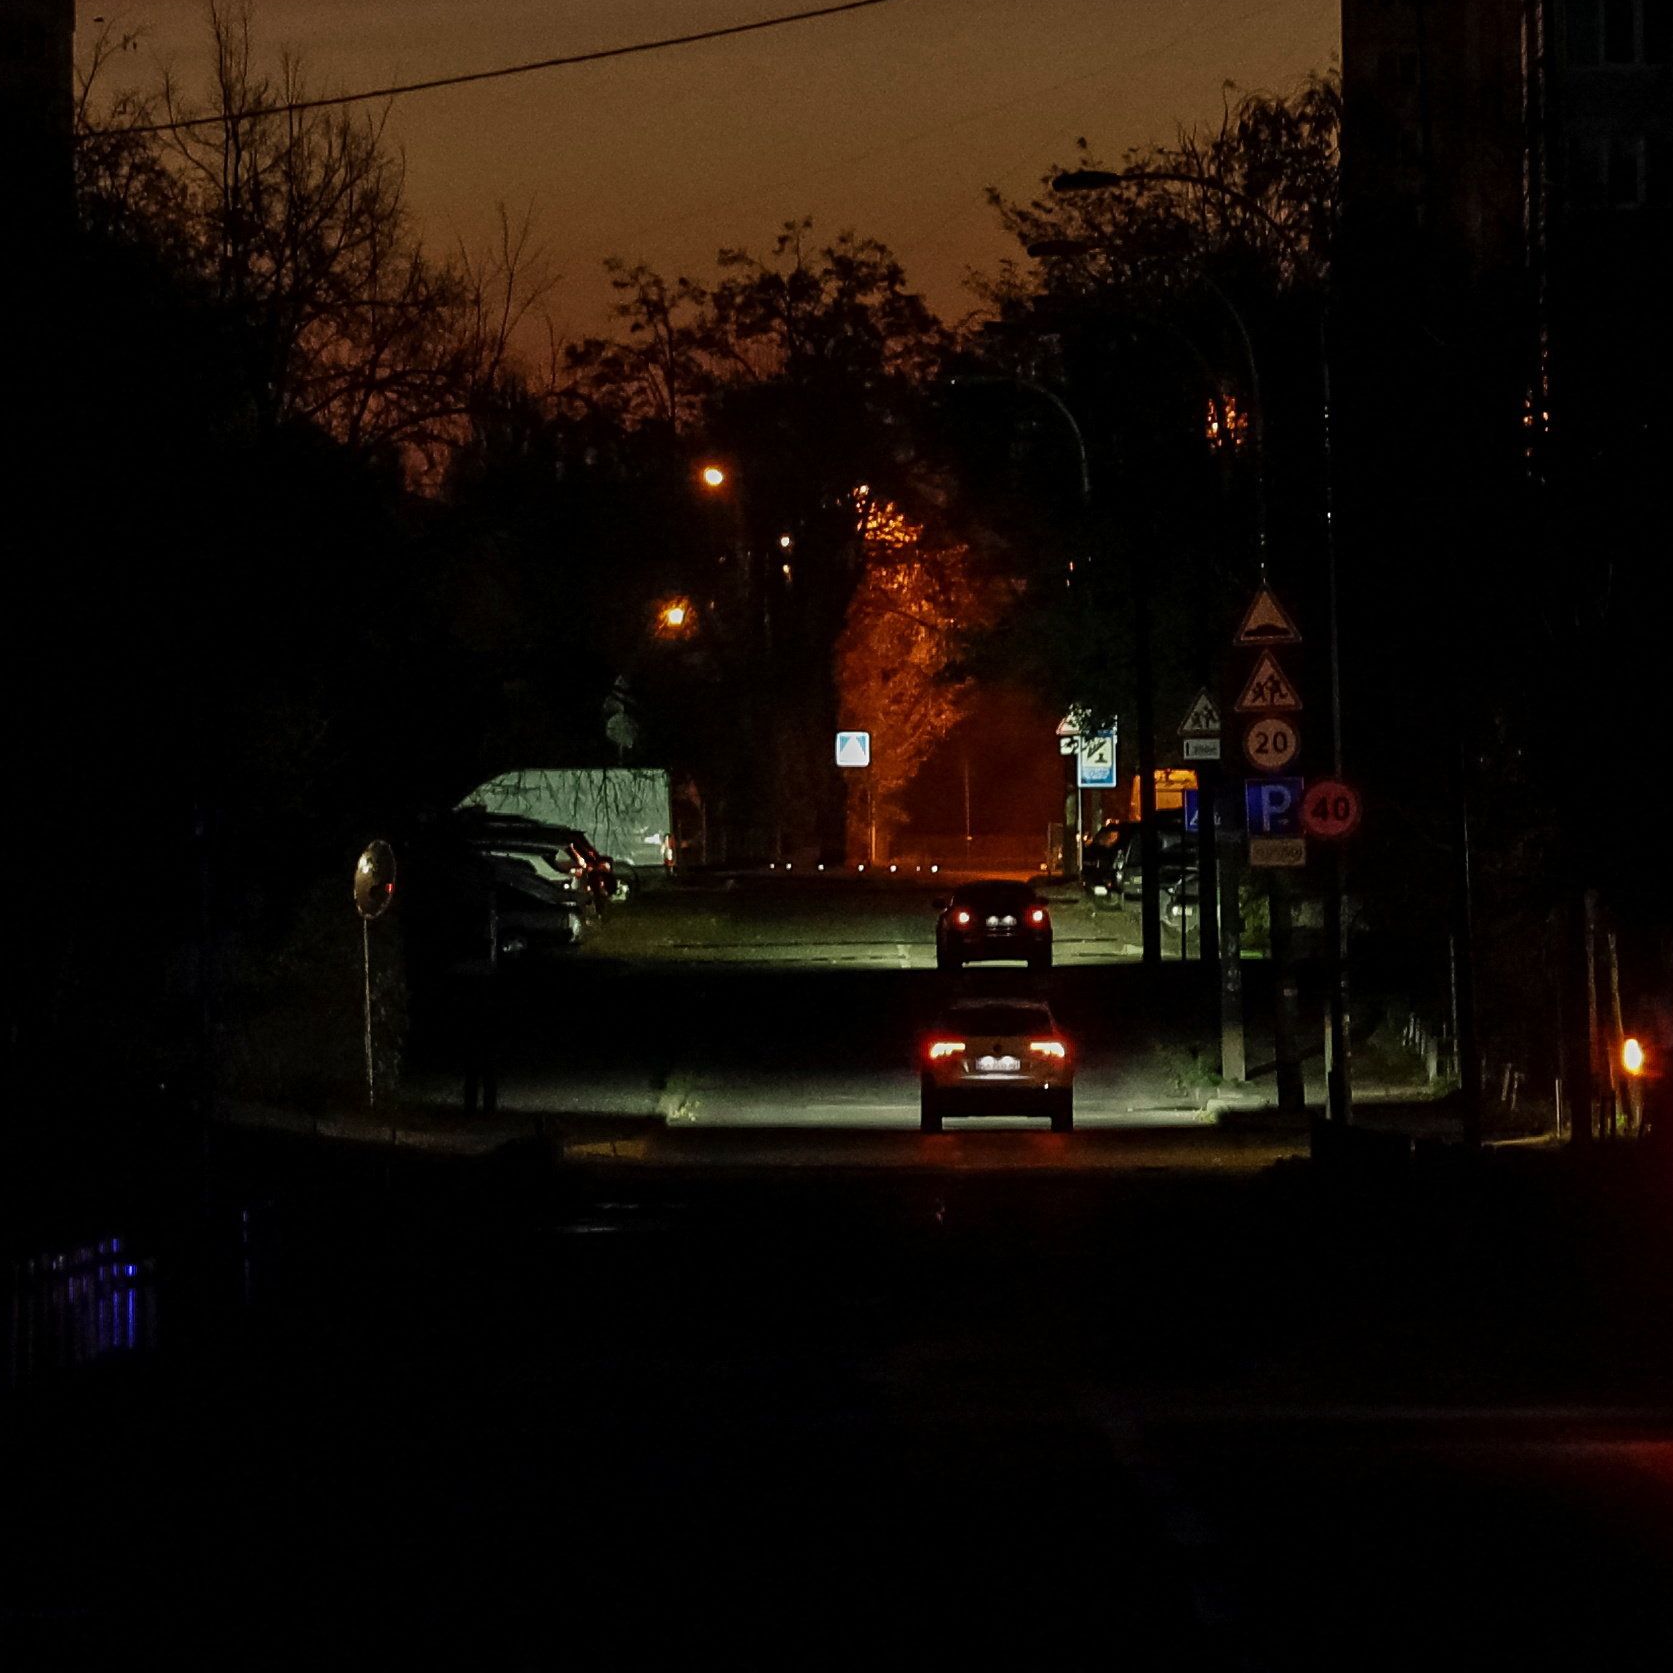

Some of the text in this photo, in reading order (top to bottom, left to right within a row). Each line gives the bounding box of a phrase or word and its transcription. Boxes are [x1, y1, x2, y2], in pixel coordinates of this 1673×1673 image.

[1255, 731, 1288, 755] 20
[1261, 784, 1293, 832] P
[1311, 795, 1351, 823] 40
